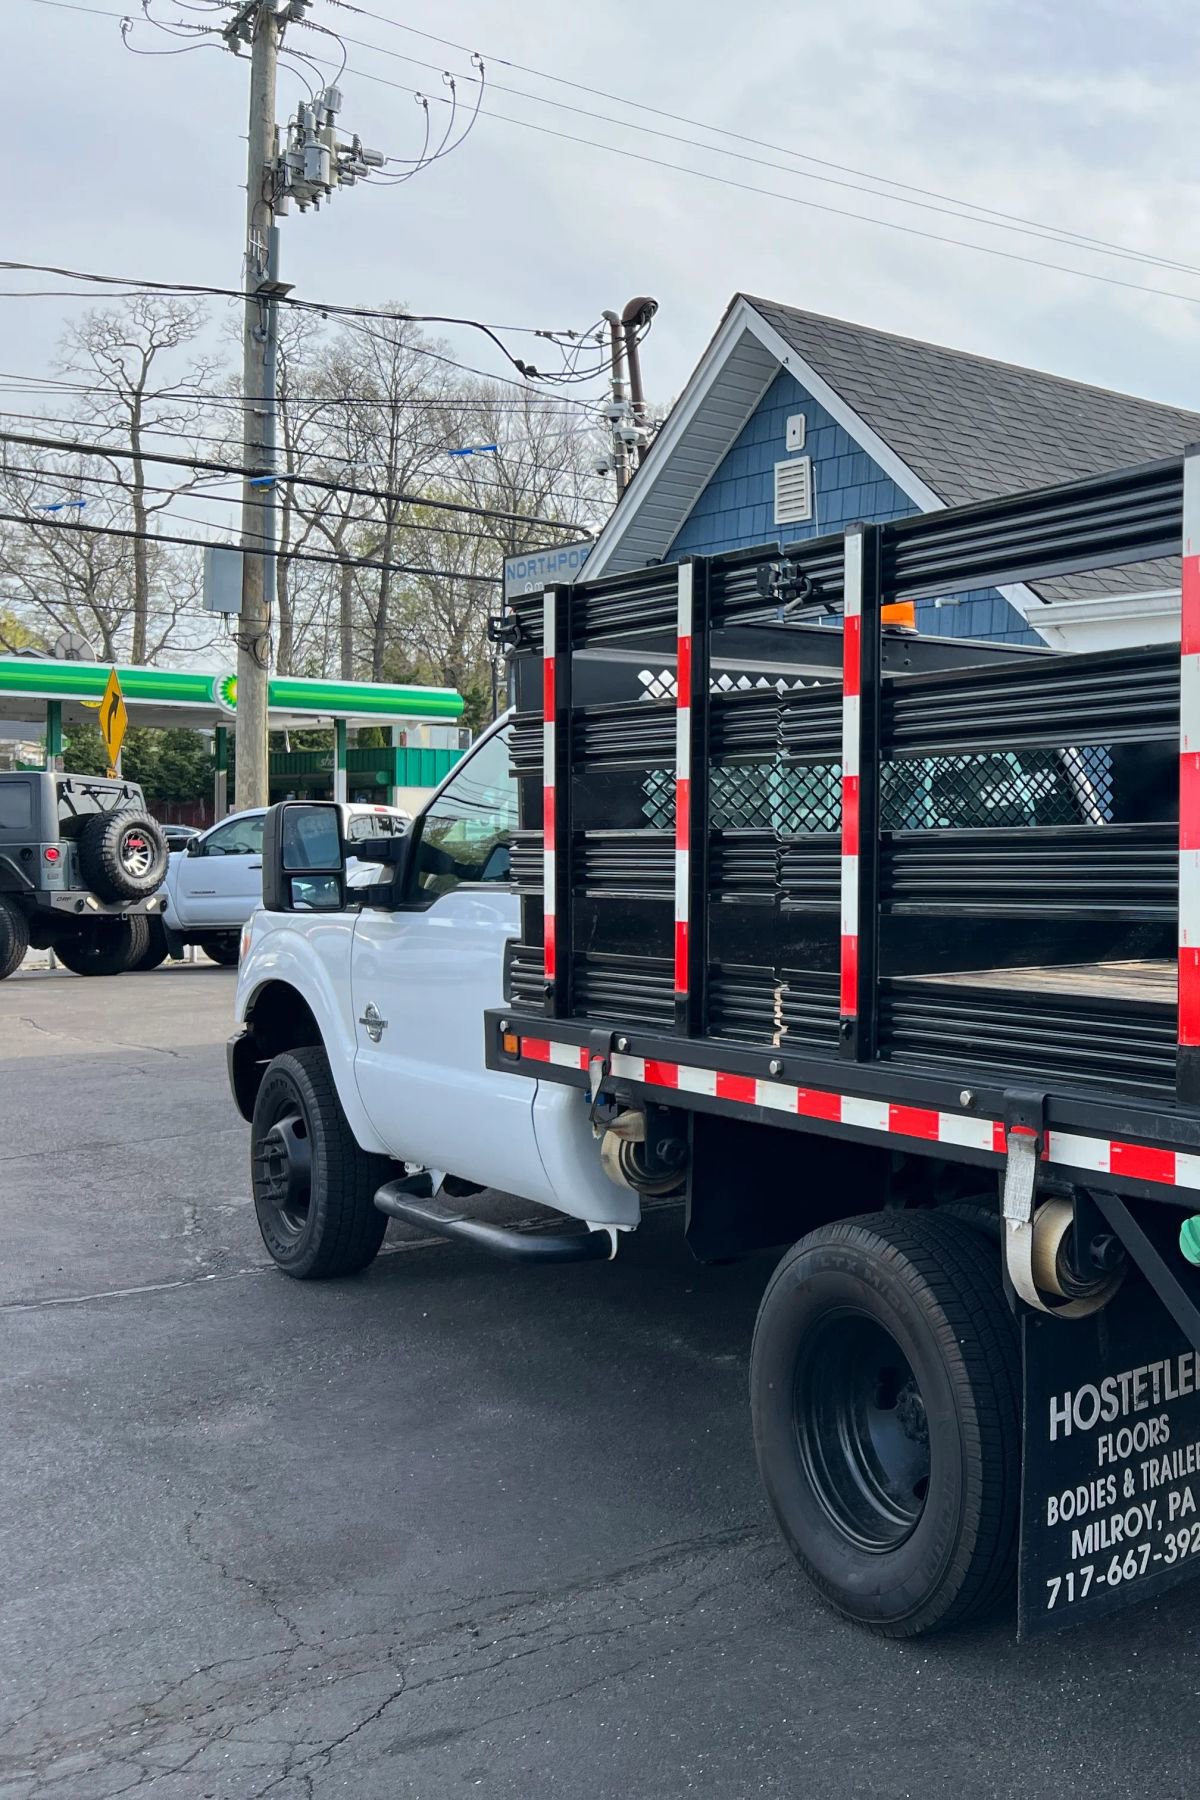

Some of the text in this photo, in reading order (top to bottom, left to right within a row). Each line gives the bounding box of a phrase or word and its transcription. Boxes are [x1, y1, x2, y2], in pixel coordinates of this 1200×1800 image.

[319, 753, 334, 767] sho
[1098, 1413, 1170, 1466] FLOORS
[1047, 1474, 1117, 1527] BODIES
[1123, 1467, 1136, 1499] &
[1071, 1486, 1197, 1560] MILROY, PA
